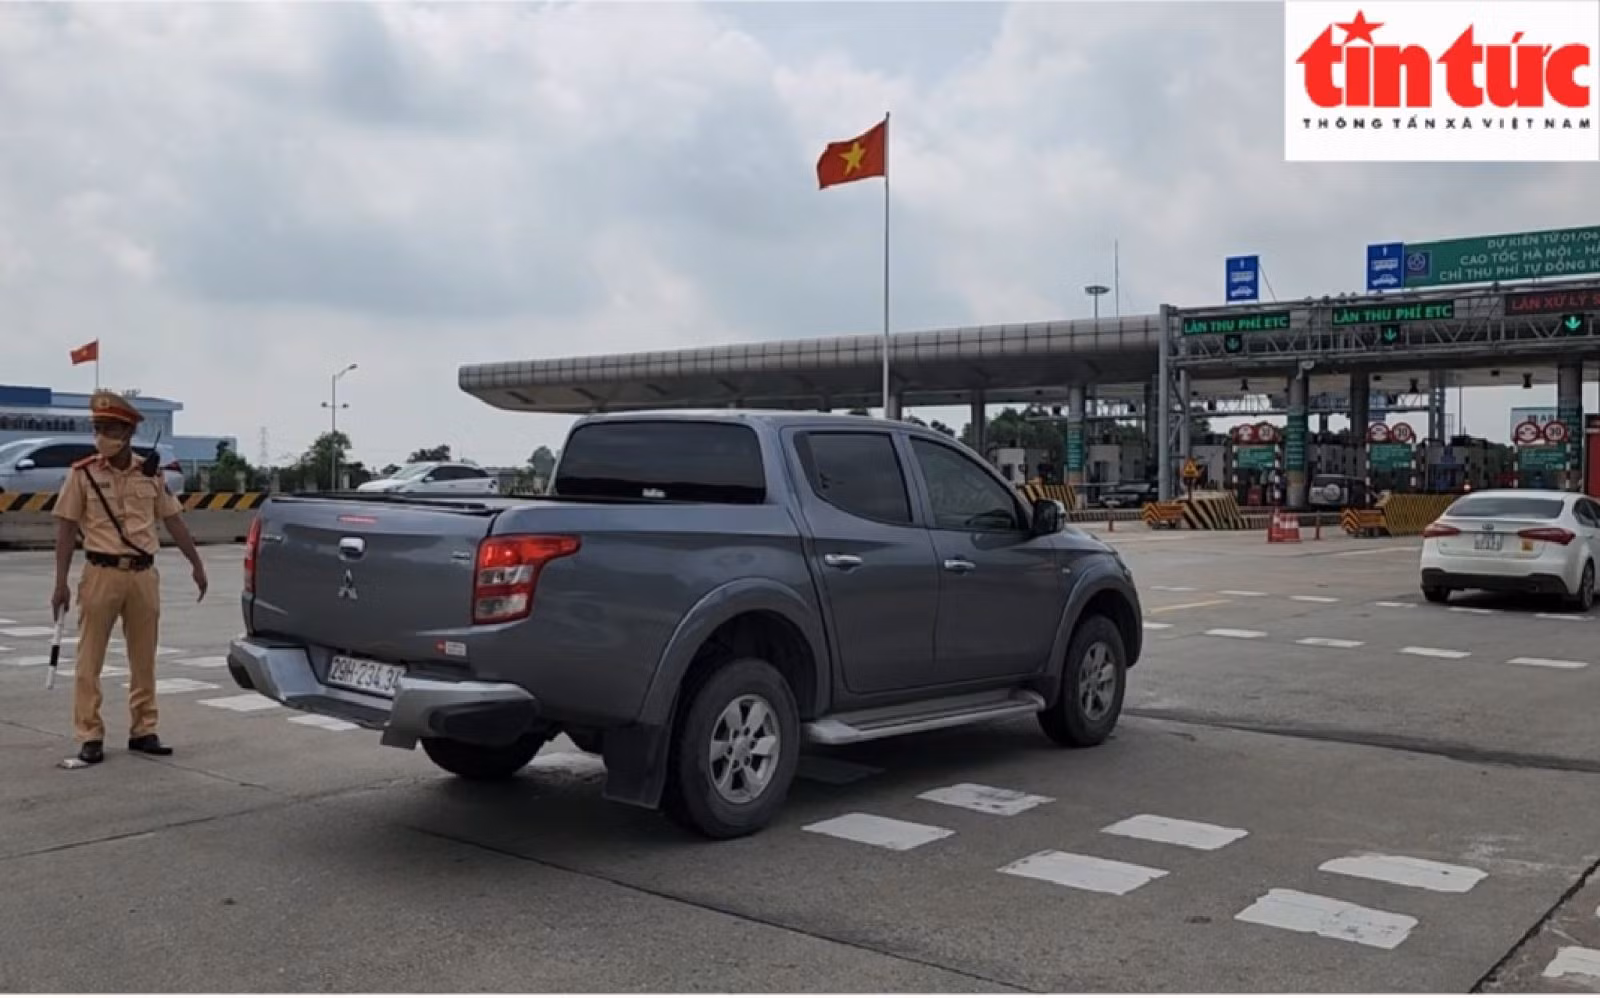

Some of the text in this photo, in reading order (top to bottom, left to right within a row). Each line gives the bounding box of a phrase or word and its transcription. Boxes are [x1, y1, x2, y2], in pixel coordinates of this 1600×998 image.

[1460, 253, 1488, 266] CAO
[1491, 247, 1519, 264] TỐC
[1522, 246, 1542, 261] HÀ
[1545, 244, 1572, 260] NỘI
[1466, 267, 1492, 280] THU
[1496, 263, 1519, 278] PHÍ
[1364, 308, 1392, 322] THU
[1396, 304, 1422, 320] PHÍ
[1425, 304, 1453, 319] ETC
[1211, 319, 1235, 331] THU
[1264, 315, 1288, 328] ETC
